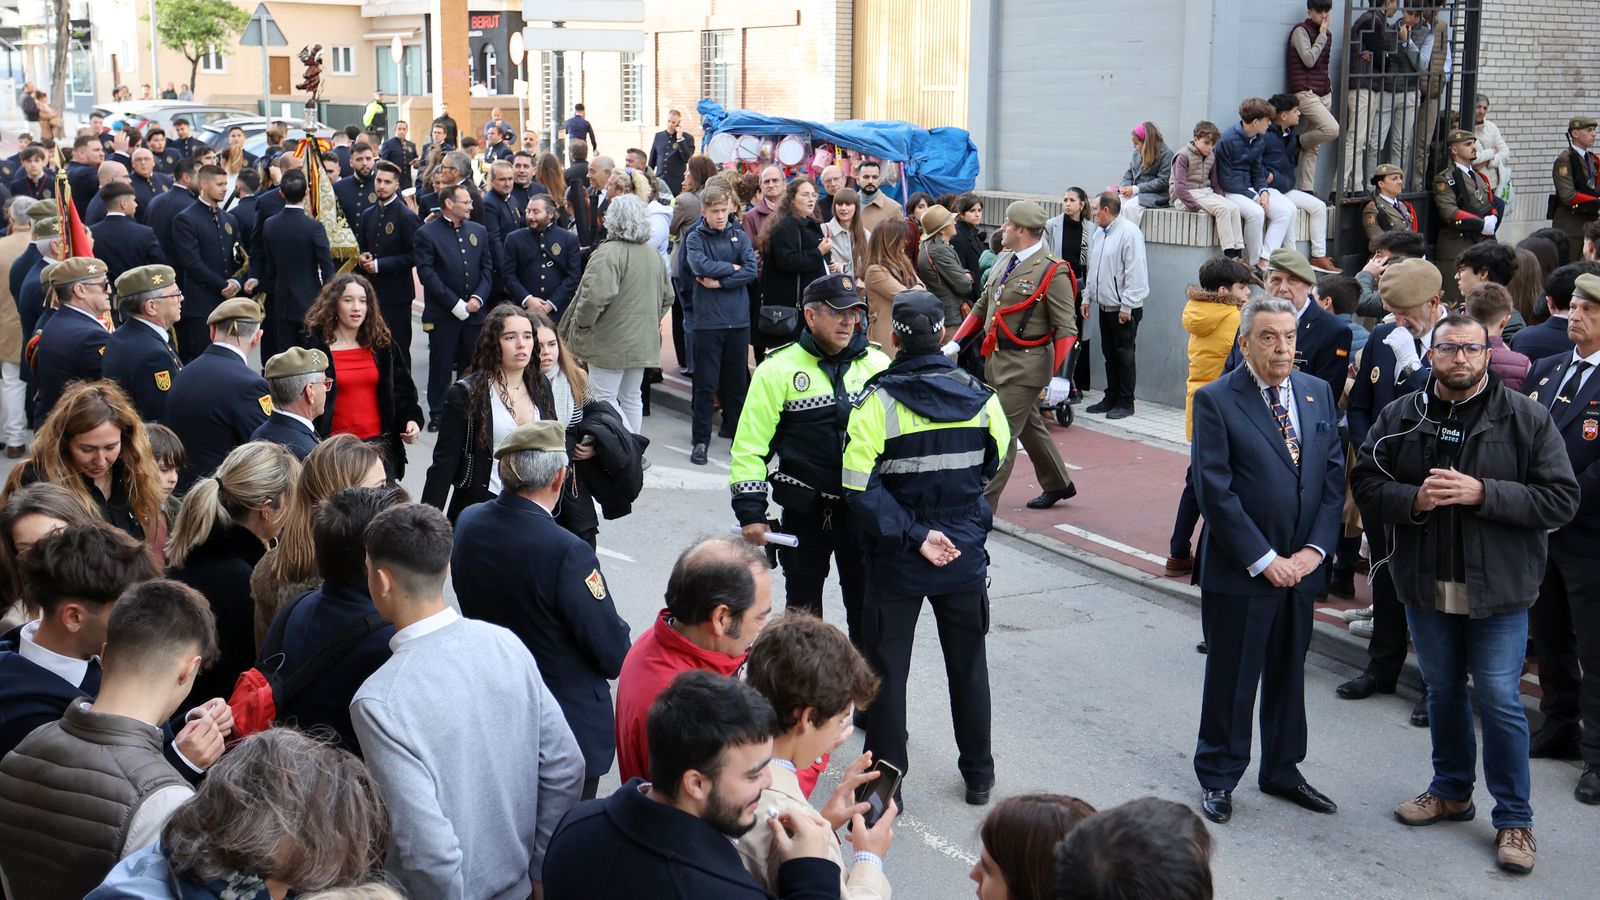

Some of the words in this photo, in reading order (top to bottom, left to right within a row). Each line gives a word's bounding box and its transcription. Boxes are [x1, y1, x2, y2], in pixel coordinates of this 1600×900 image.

[471, 15, 500, 29] BEIRUT
[1441, 427, 1460, 437] Onda
[1440, 434, 1459, 443] Jerez
